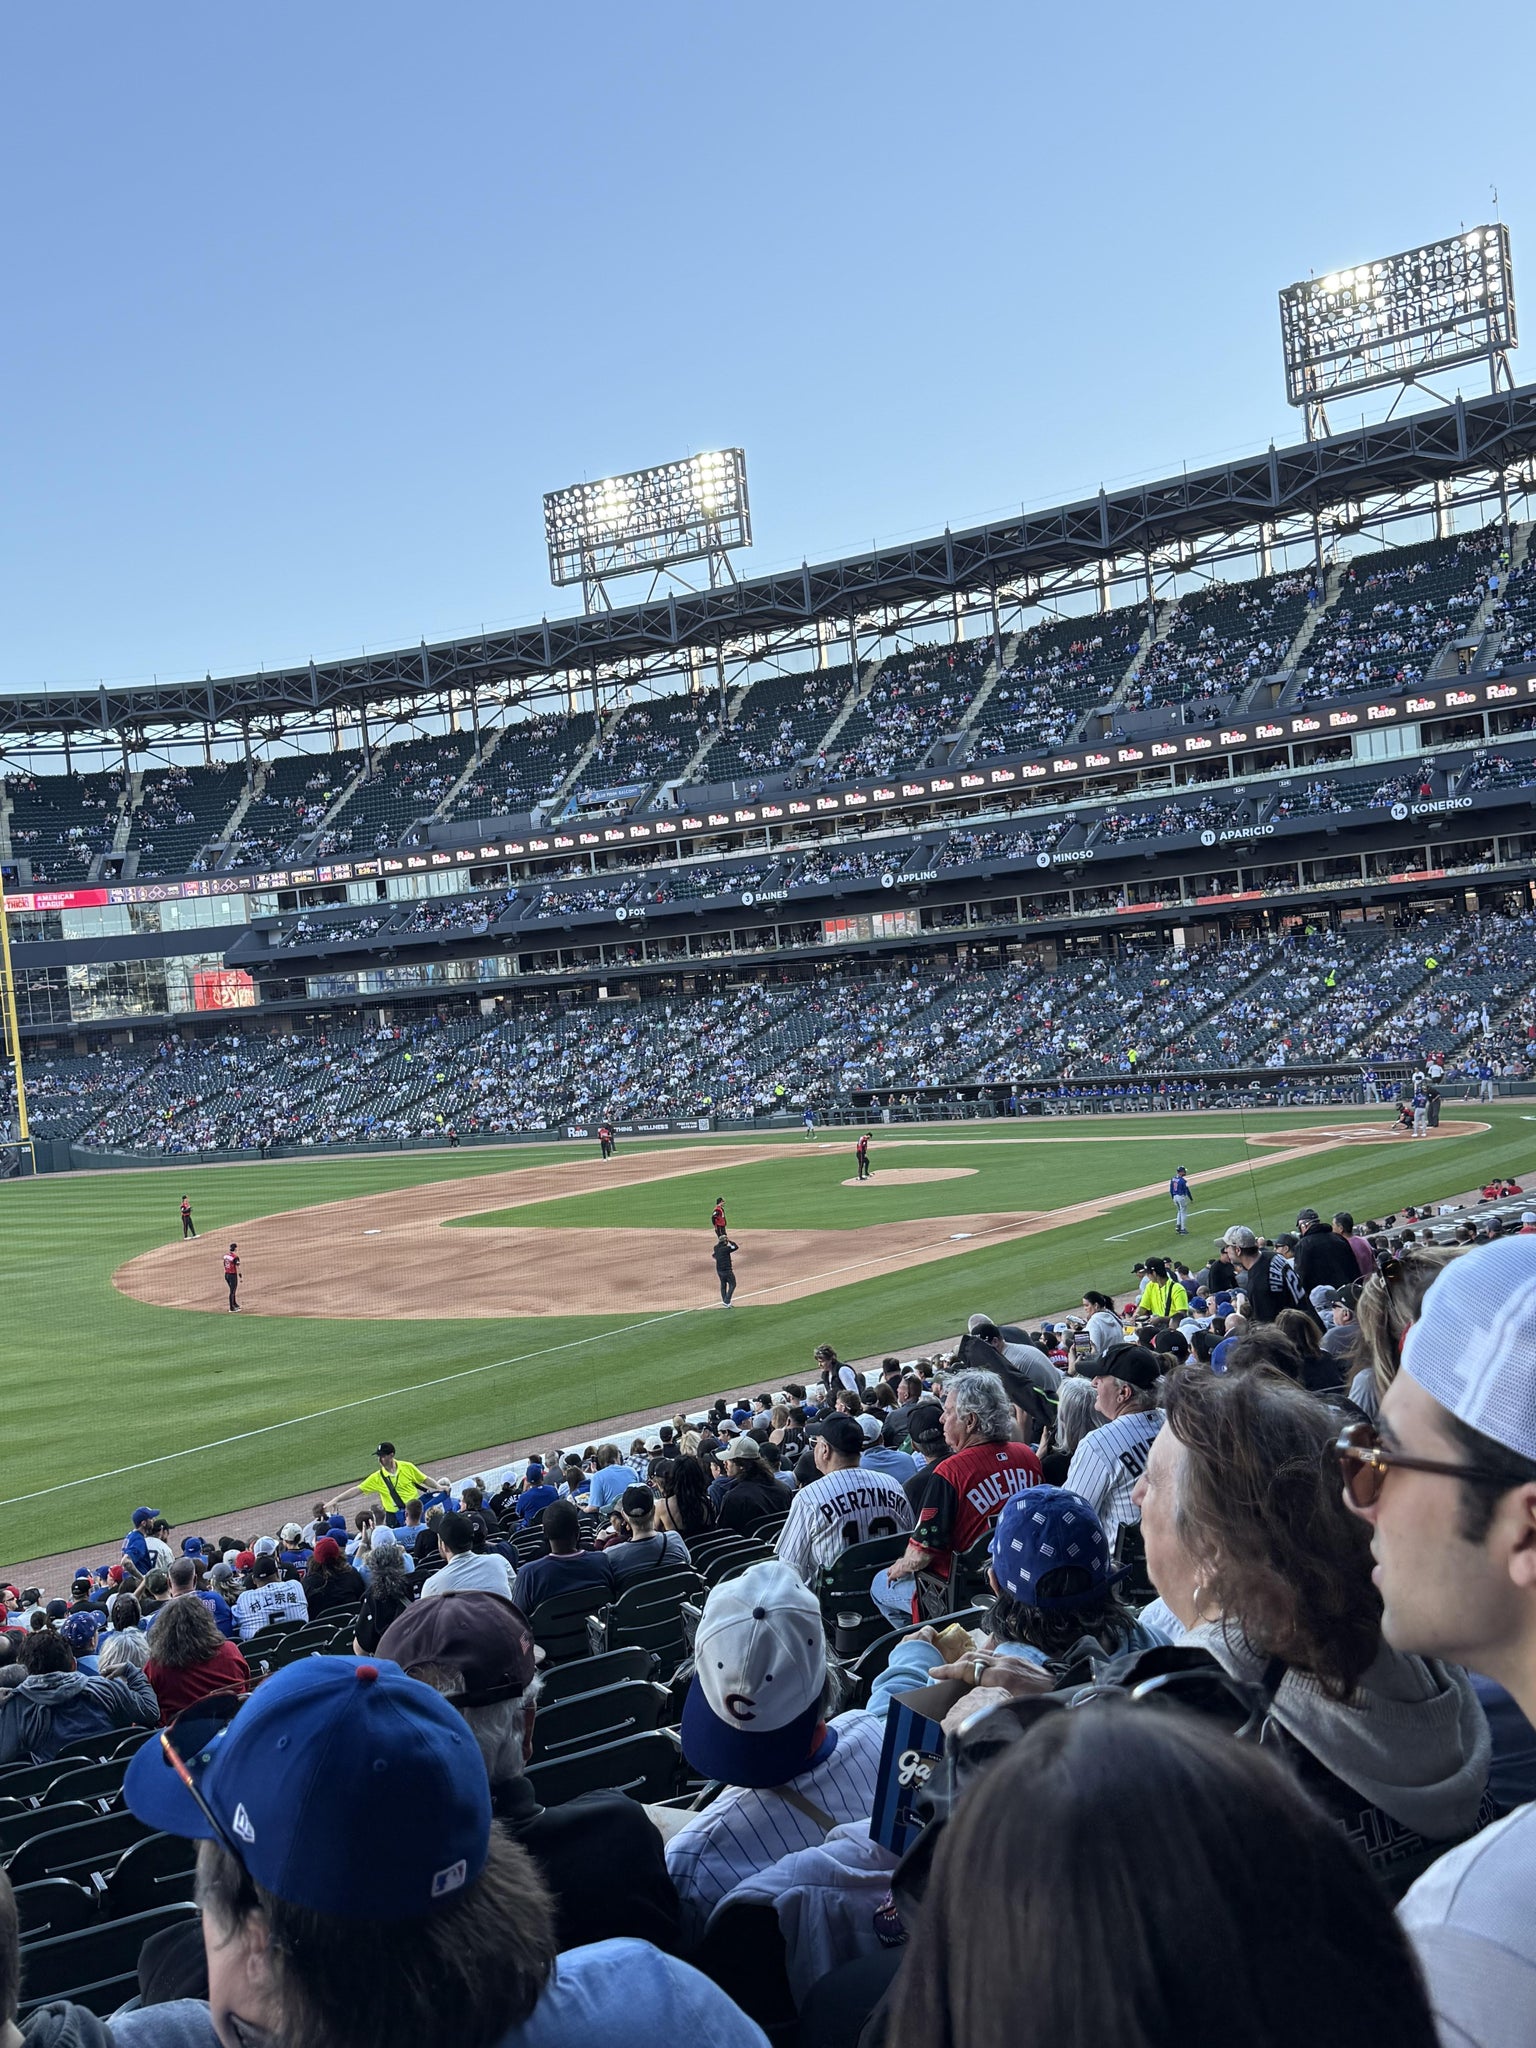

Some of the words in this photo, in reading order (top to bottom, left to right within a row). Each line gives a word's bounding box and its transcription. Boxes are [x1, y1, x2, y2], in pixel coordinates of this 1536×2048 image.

[1487, 685, 1517, 699] Rate
[1446, 692, 1476, 706] Rate
[1406, 698, 1436, 713] Rate
[1368, 706, 1396, 719] Rate
[1330, 712, 1357, 726] Rate
[1256, 725, 1283, 738] Rate
[1292, 719, 1320, 732] Rate
[1220, 731, 1246, 744] Rate
[1152, 743, 1177, 756] Rate
[1186, 738, 1211, 750] Rate
[1086, 754, 1110, 767] Rate
[1118, 749, 1143, 761] Rate
[1023, 765, 1046, 777] Rate
[1054, 760, 1077, 772] Rate
[961, 775, 984, 787] Rate
[992, 770, 1014, 782] Rate
[903, 785, 924, 796] Rate
[931, 780, 954, 792] Rate
[845, 794, 866, 805] Rate
[873, 789, 895, 801] Rate
[789, 802, 810, 813] Rate
[817, 798, 838, 809] Rate
[1411, 797, 1472, 814] KONERKO
[735, 811, 755, 822] Rate
[762, 806, 782, 818] Rate
[682, 819, 702, 829] Rate
[709, 815, 729, 825] Rate
[630, 826, 650, 837] Rate
[656, 823, 676, 833] Rate
[1219, 825, 1274, 840] APARICIO
[580, 834, 599, 844] Rate
[605, 830, 624, 840] Rate
[530, 841, 548, 851] Rate
[555, 837, 573, 847] Rate
[481, 848, 499, 857] Rate
[505, 844, 524, 854] Rate
[1052, 850, 1094, 863] MINOSO
[896, 870, 937, 883] APPLING
[37, 893, 75, 902] AMERICAN
[755, 890, 788, 901] BAINES
[38, 900, 65, 909] LEAGUE
[629, 907, 645, 916] FOX
[567, 1126, 588, 1138] Rate
[966, 1468, 1041, 1515] BUEHR
[820, 1488, 907, 1523] PIERZYNSKI
[725, 1693, 756, 1721] C
